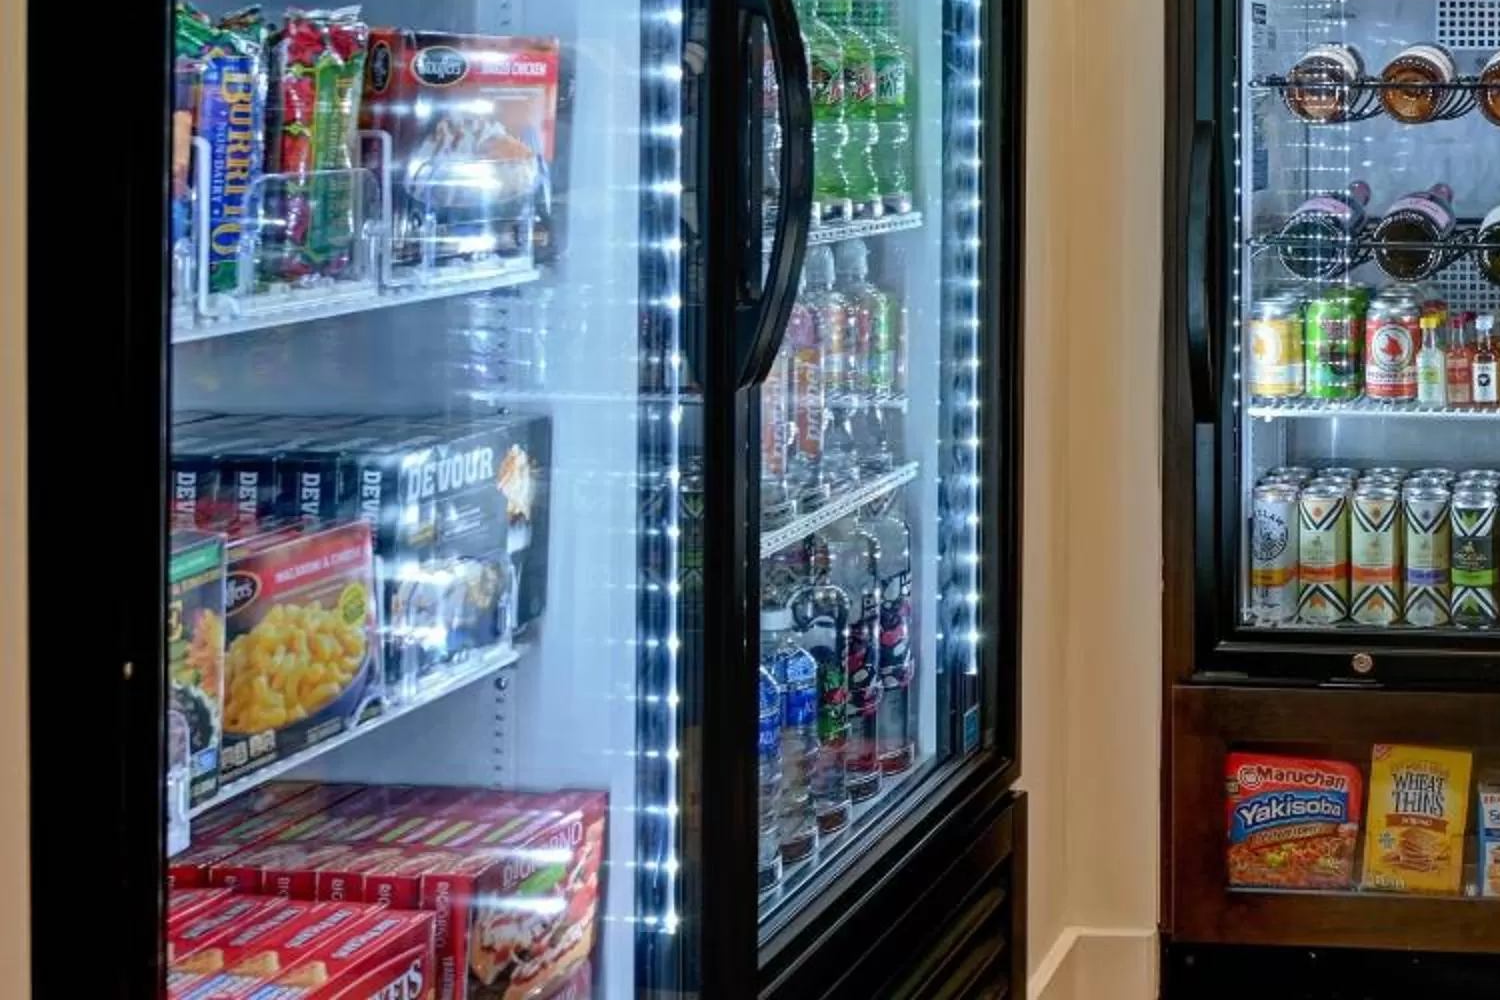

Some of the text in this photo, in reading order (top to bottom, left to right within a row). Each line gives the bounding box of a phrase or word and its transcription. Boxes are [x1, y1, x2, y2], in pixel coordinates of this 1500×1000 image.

[211, 67, 253, 256] BURRITO
[406, 446, 495, 501] DEVOUR
[1258, 766, 1347, 790] Maruchan
[1391, 772, 1446, 792] WHEAT
[1240, 793, 1343, 826] Yakisoba
[1391, 790, 1446, 818] THINS
